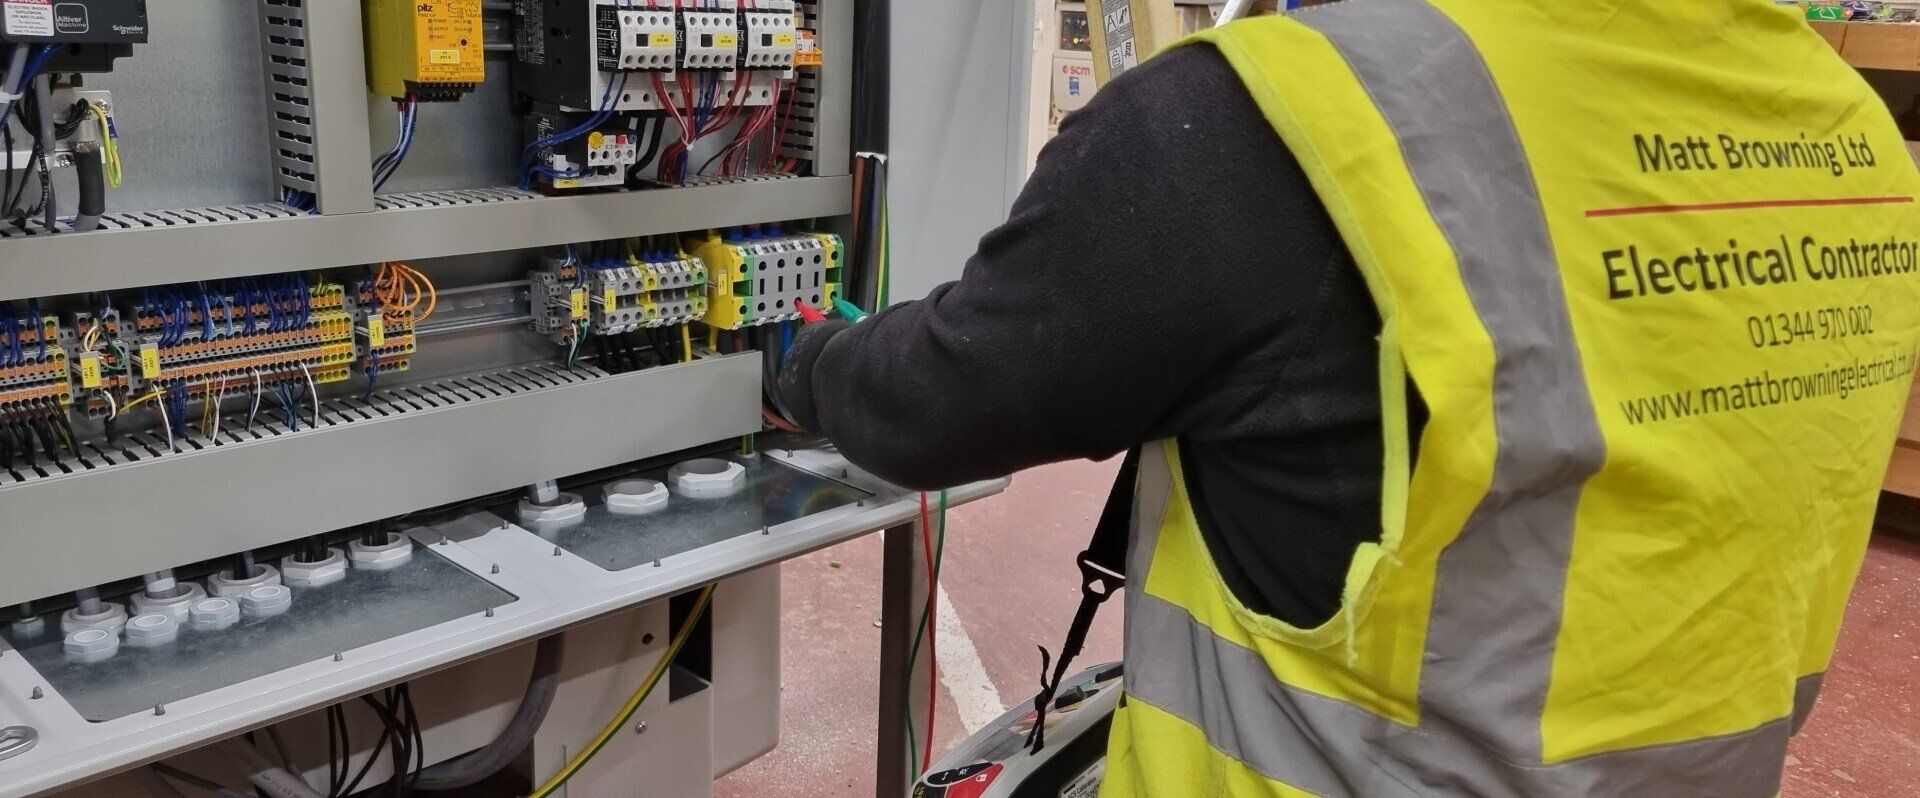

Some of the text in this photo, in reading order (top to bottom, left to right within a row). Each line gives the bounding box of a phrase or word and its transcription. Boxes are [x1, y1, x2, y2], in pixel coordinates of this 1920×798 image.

[418, 4, 433, 12] pilz
[112, 25, 144, 34] Schneider
[1070, 66, 1090, 76] scm
[1634, 132, 1876, 177] Matt Browning Ltd
[1602, 234, 1918, 300] Electrical Contractor
[1748, 304, 1874, 348] 01344 970 002
